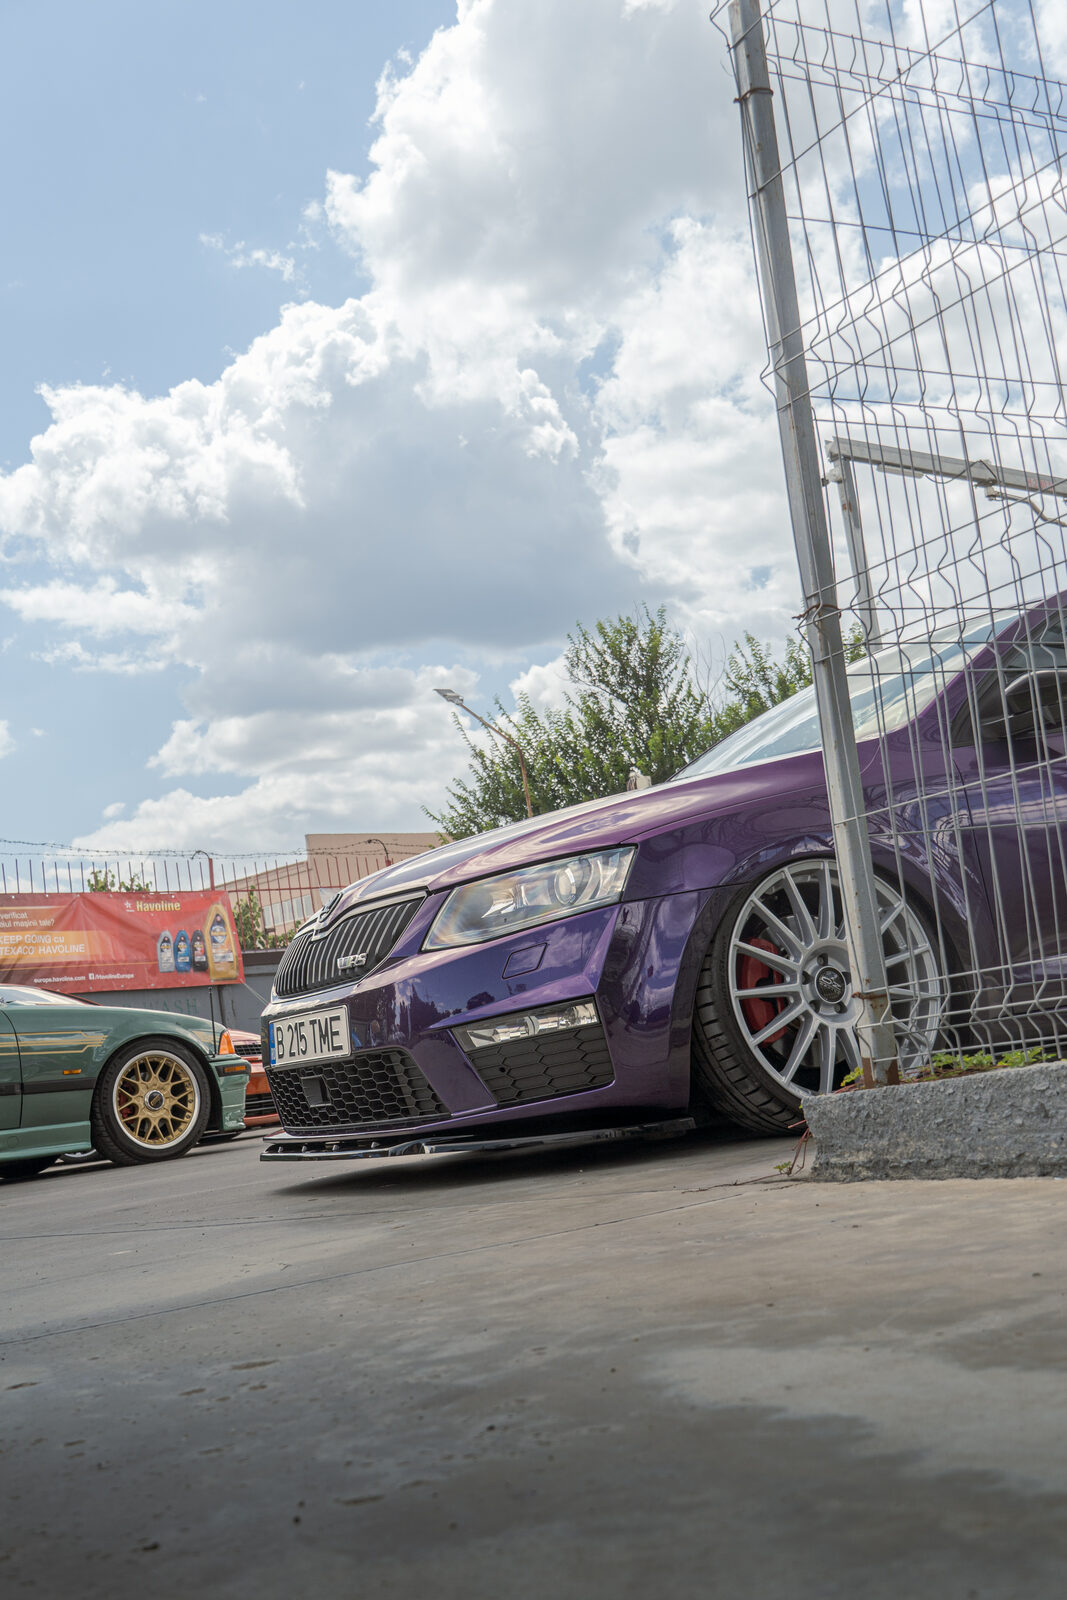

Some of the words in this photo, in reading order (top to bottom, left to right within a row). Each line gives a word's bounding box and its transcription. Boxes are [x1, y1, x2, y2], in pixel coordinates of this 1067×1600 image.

[136, 900, 181, 912] Havoline
[39, 918, 55, 927] tale?
[24, 934, 51, 944] GOING
[53, 935, 65, 943] cu
[38, 943, 85, 954] HAVOLINE
[276, 1026, 285, 1059] B
[287, 1021, 308, 1058] 215
[309, 1015, 343, 1054] TME
